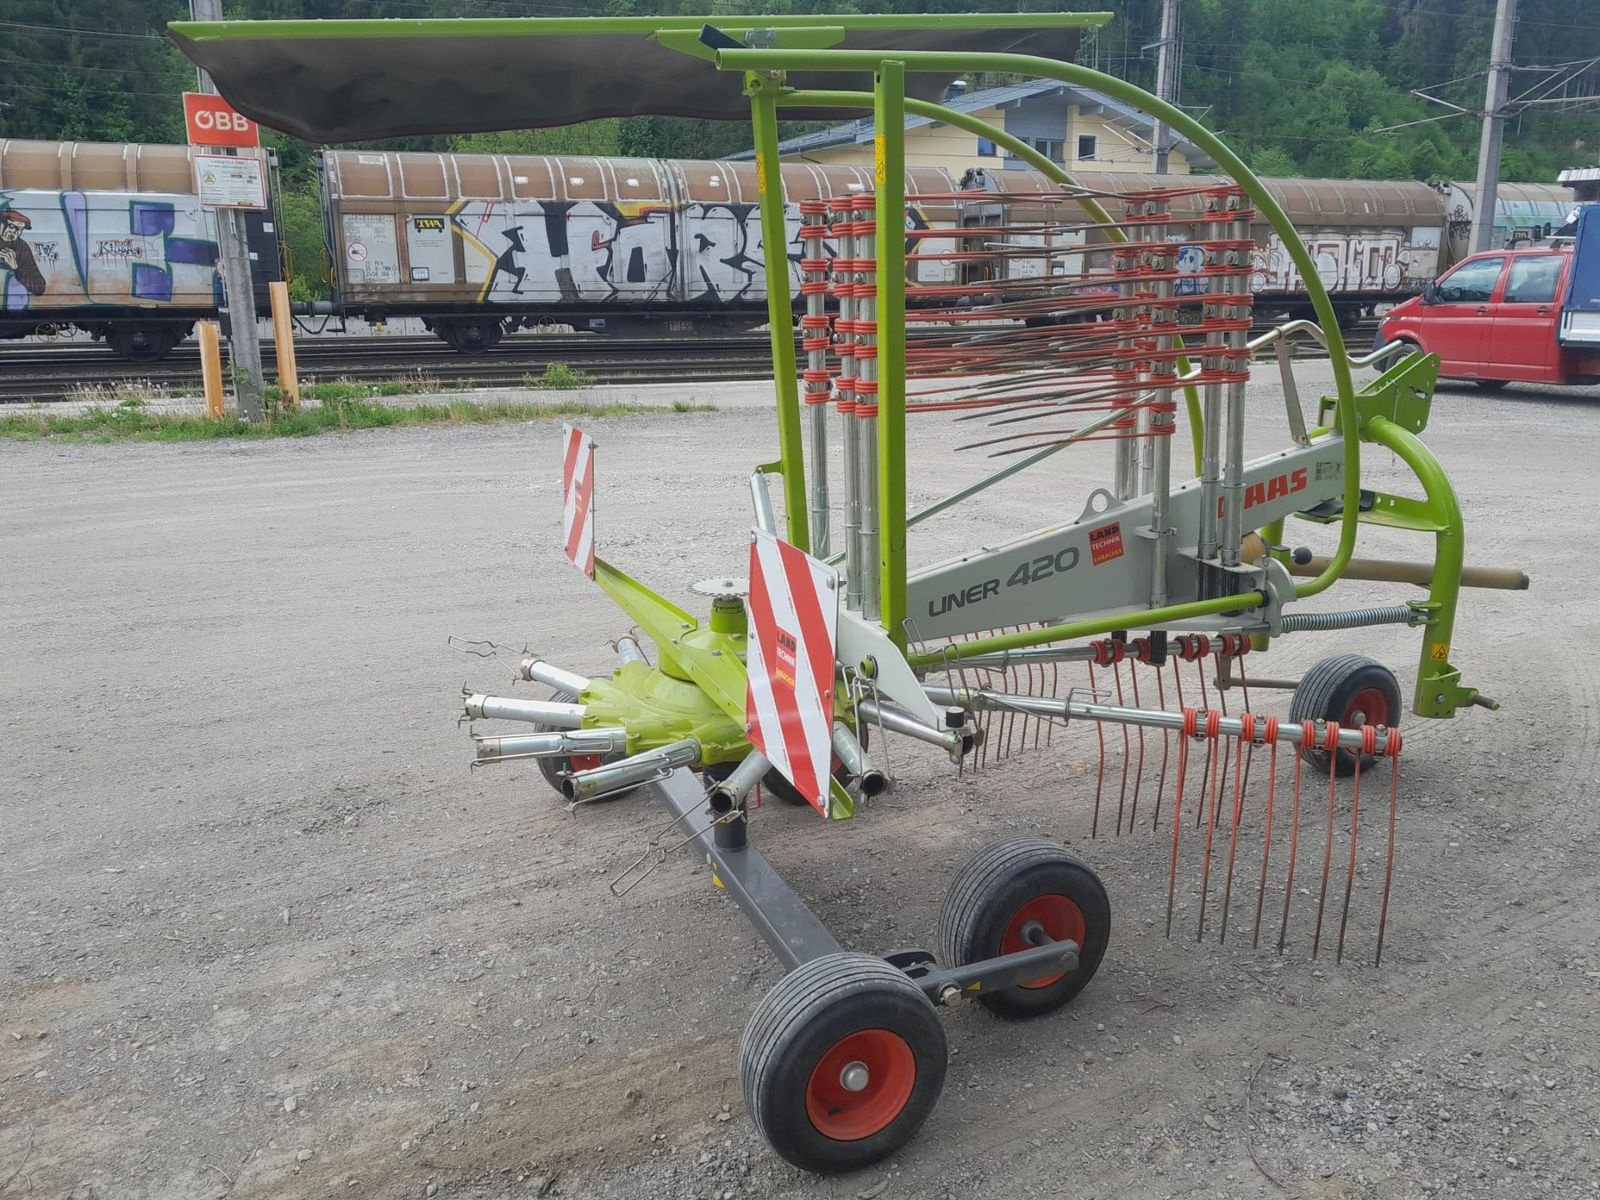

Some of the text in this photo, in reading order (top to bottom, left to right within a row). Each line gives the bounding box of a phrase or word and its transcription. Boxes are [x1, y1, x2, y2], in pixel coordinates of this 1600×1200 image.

[195, 110, 249, 131] ÖBB
[417, 219, 443, 229] TWA
[1217, 467, 1308, 519] AAS
[1089, 526, 1120, 540] LAND
[1092, 535, 1121, 550] TECHNIK
[928, 546, 1080, 617] LINER 420
[776, 630, 796, 652] LAND
